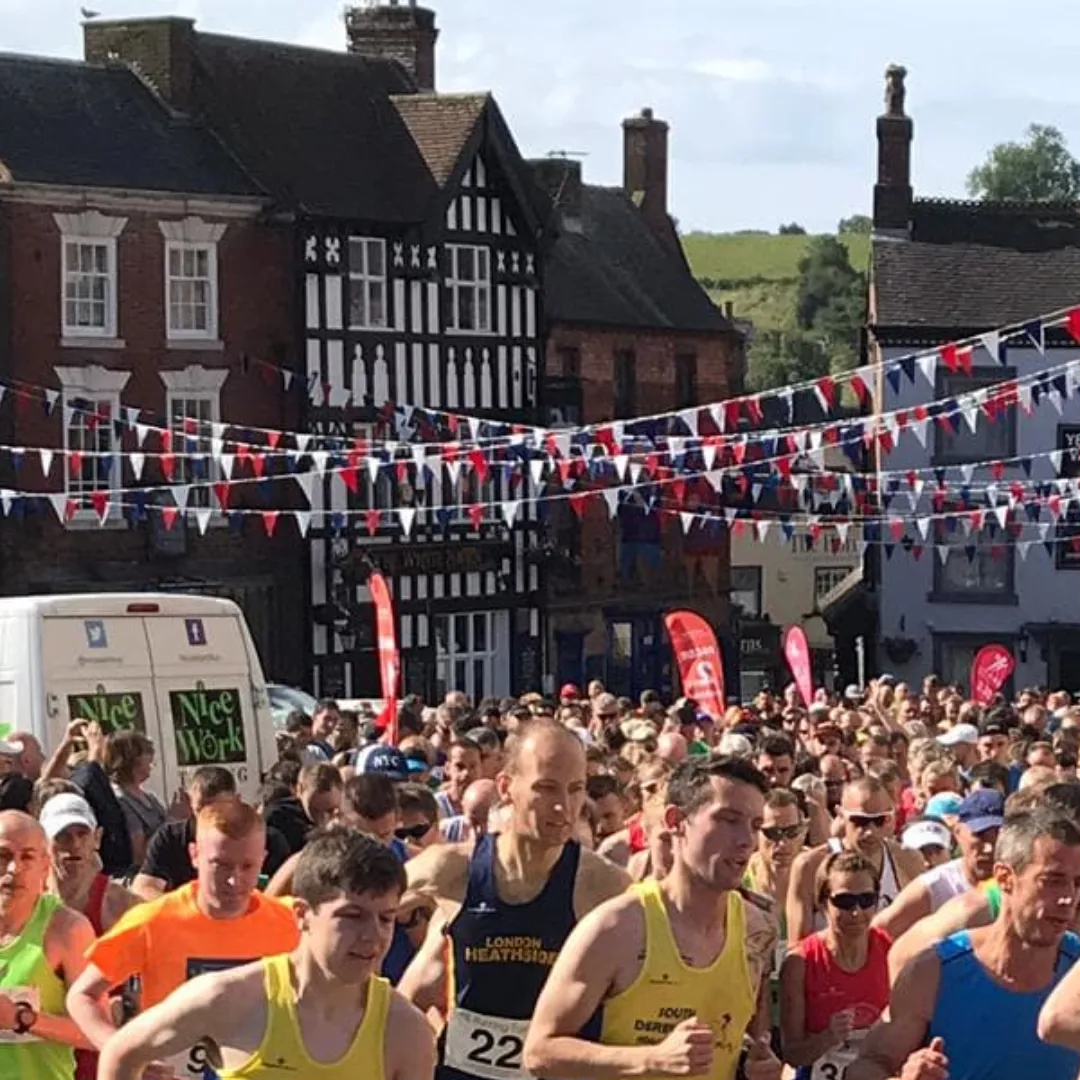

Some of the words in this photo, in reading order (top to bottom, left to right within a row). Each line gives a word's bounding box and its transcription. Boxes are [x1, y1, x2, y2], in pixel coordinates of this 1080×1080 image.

[179, 690, 234, 726] Nice
[176, 719, 243, 763] Work
[486, 936, 543, 949] LONDON
[467, 1028, 523, 1070] 22
